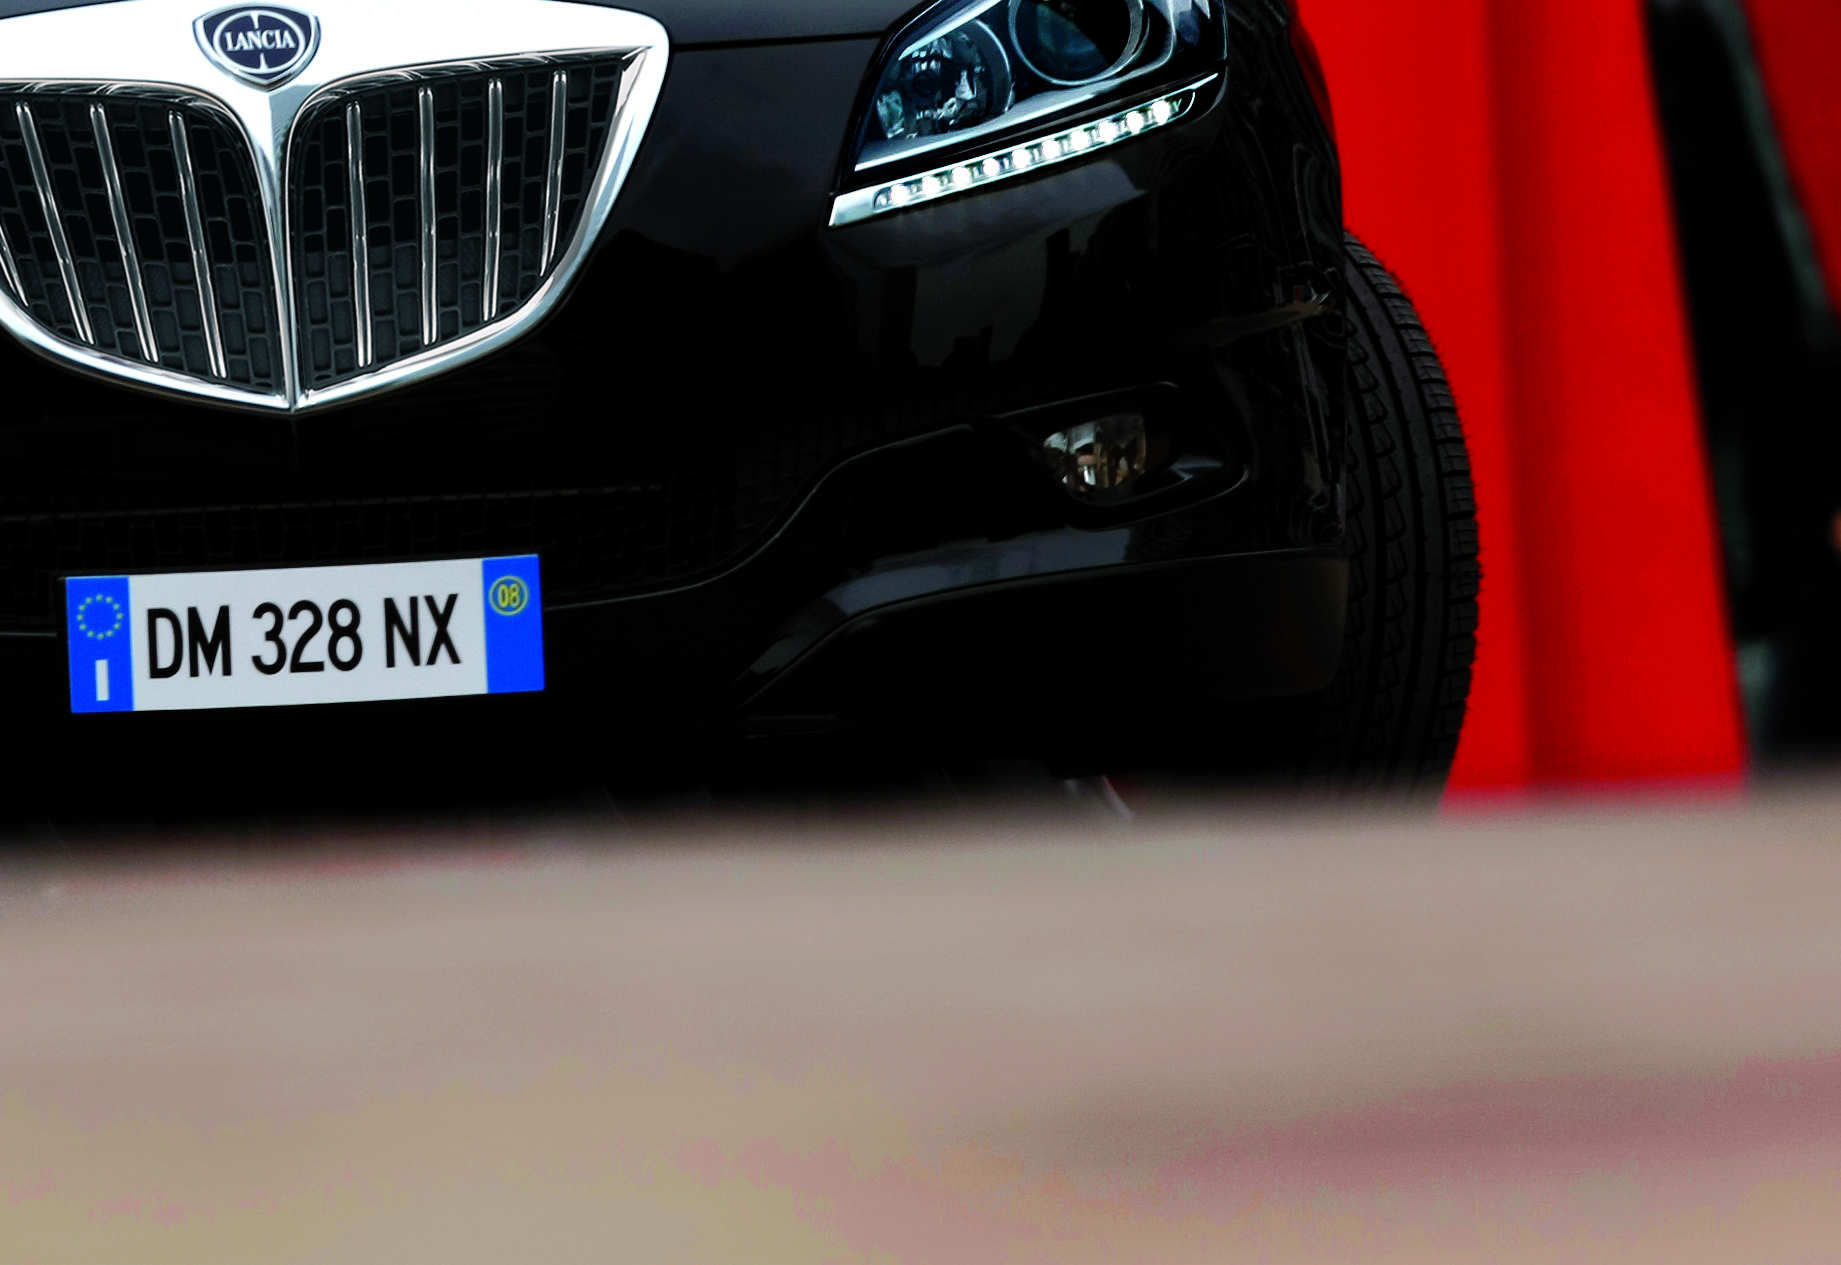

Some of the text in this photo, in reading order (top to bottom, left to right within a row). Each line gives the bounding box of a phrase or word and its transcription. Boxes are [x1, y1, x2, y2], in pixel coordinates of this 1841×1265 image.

[225, 28, 296, 51] LANCIA
[498, 583, 520, 607] 08
[146, 593, 462, 679] DM 328 NX
[95, 659, 109, 701] I
